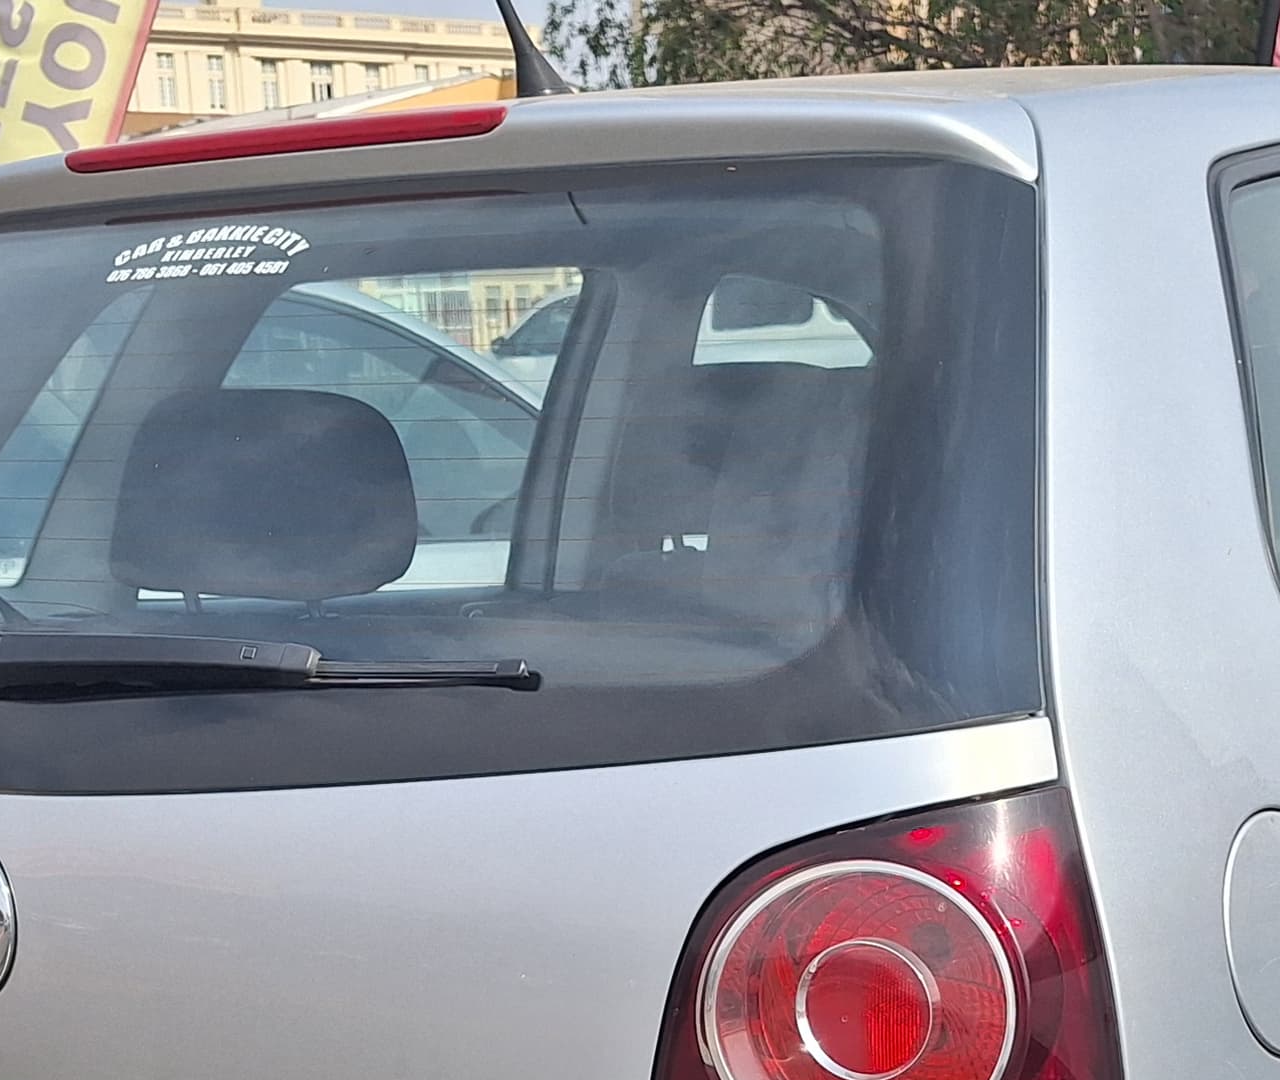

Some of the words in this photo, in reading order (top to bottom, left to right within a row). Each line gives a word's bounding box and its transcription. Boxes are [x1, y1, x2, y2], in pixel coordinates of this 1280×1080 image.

[114, 237, 166, 266] CAR
[166, 234, 184, 249] &
[186, 225, 269, 244] BAKKIE
[262, 227, 310, 257] CITY
[160, 245, 257, 262] KIMBERLEY
[199, 263, 225, 276] 061
[226, 261, 254, 275] 405
